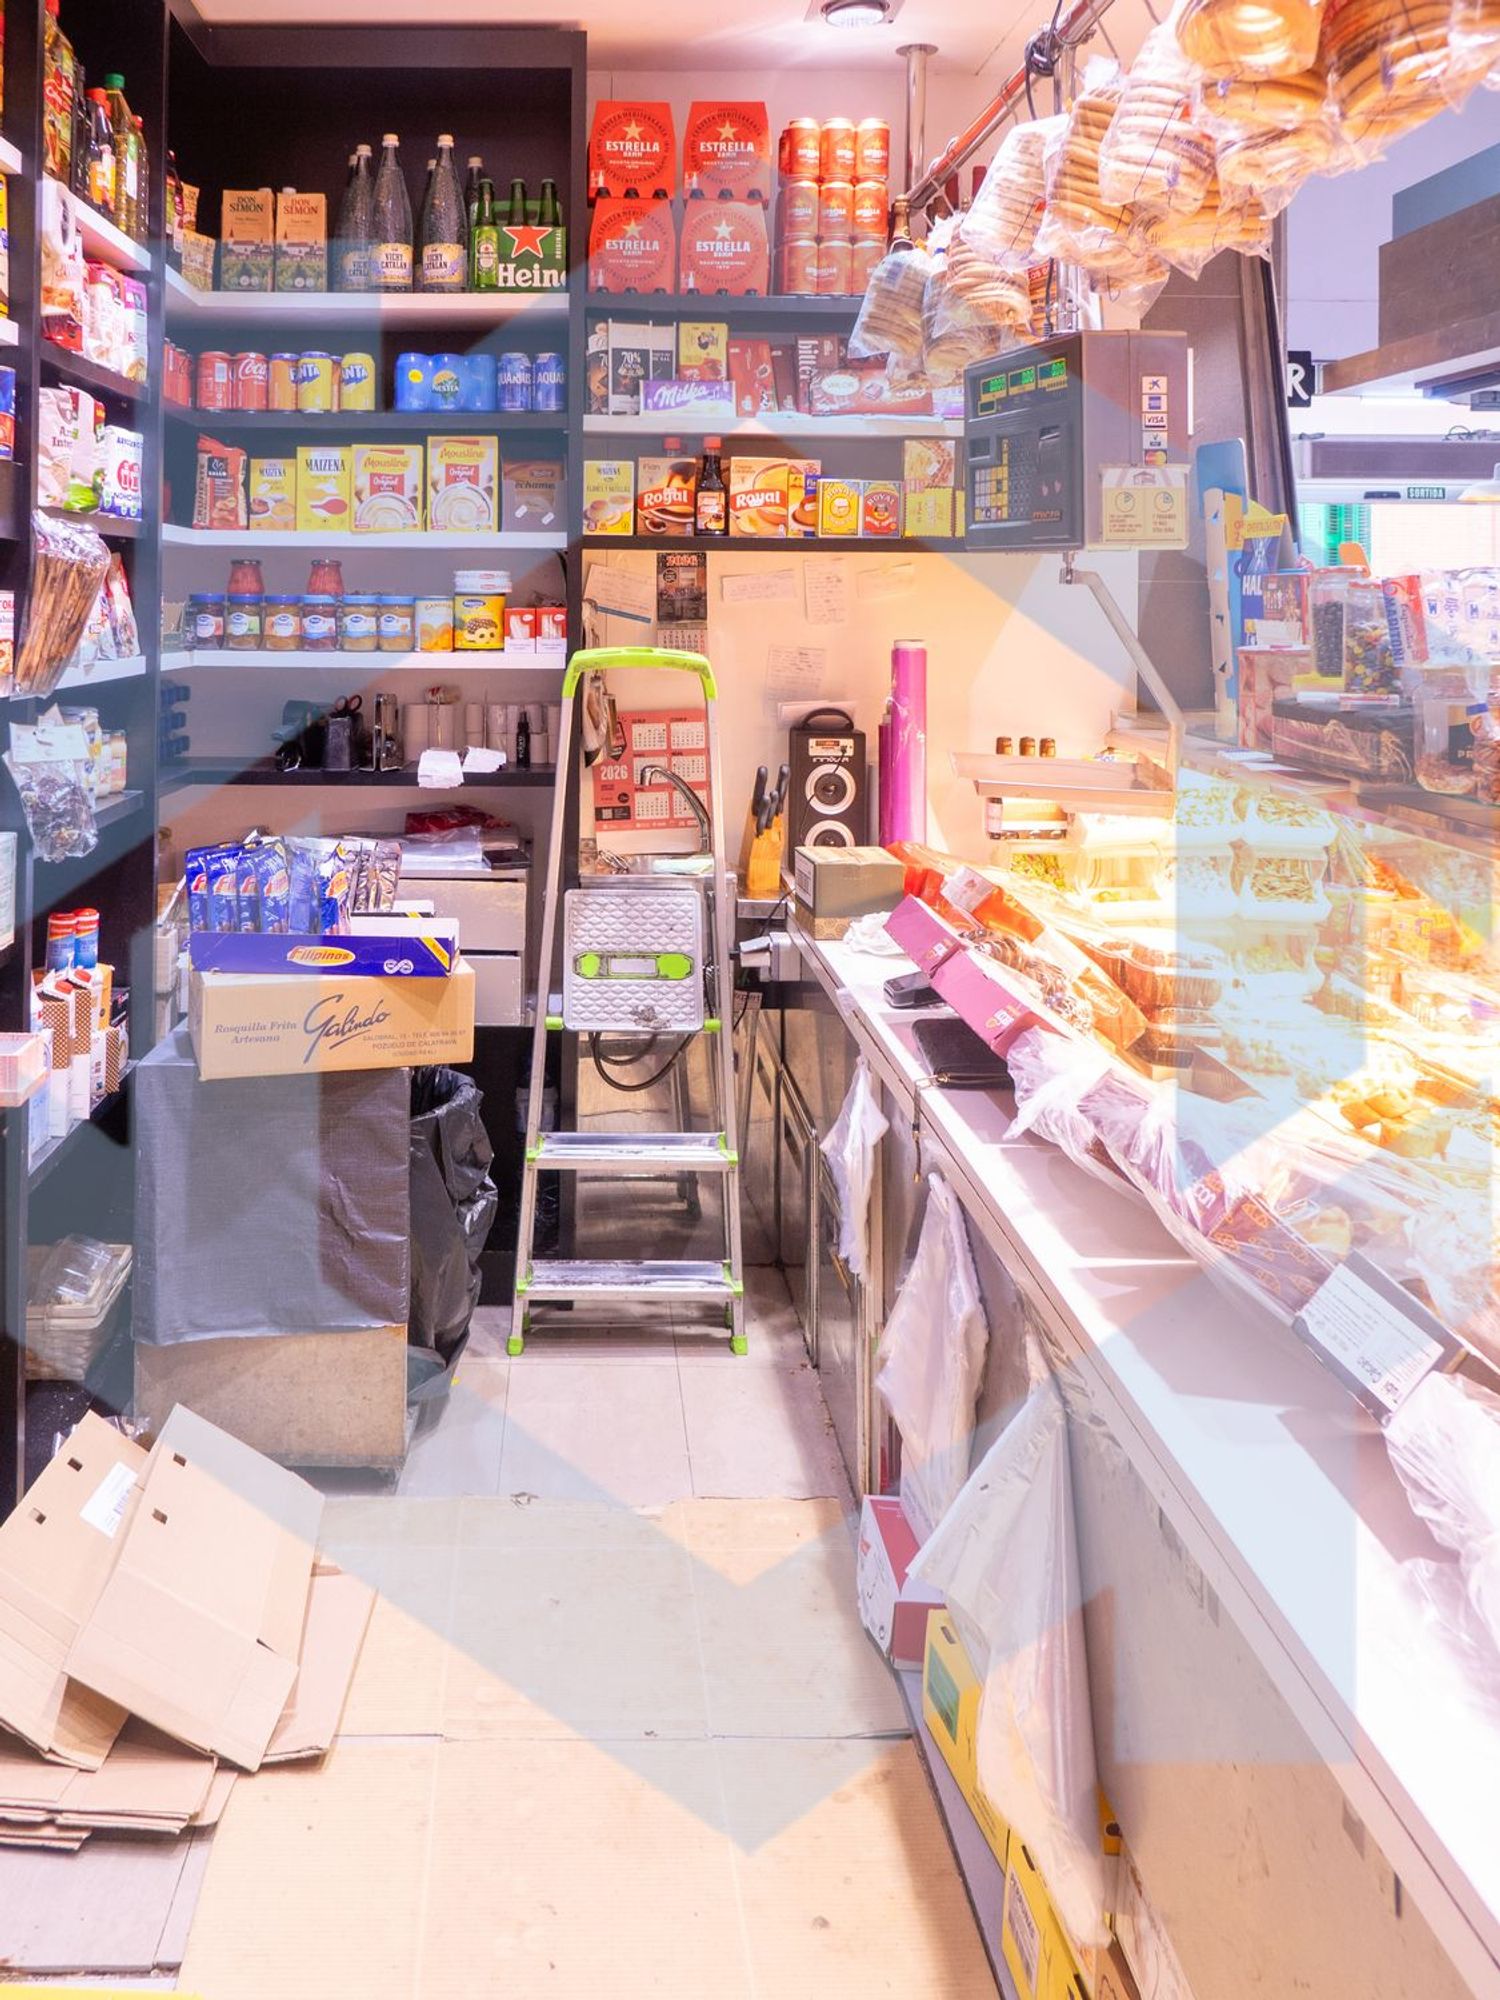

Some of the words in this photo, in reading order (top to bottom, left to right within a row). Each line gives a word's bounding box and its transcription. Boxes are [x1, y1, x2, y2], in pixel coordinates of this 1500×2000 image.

[606, 141, 660, 152] ESTRELLA
[700, 141, 755, 152] ESTRELLA
[605, 240, 660, 251] ESTRELLA
[696, 241, 751, 252] ESTRELLA
[653, 379, 712, 407] Milka
[305, 458, 346, 473] MAIZENA
[643, 486, 689, 508] Royal
[735, 490, 781, 508] Royal
[866, 493, 895, 505] ROYAL
[1409, 488, 1444, 499] SORTIDA
[1242, 574, 1263, 596] HAL
[600, 764, 629, 781] 2026
[289, 944, 350, 962] Filipinos
[214, 1021, 268, 1035] Rosquilla
[270, 1020, 298, 1031] Frita
